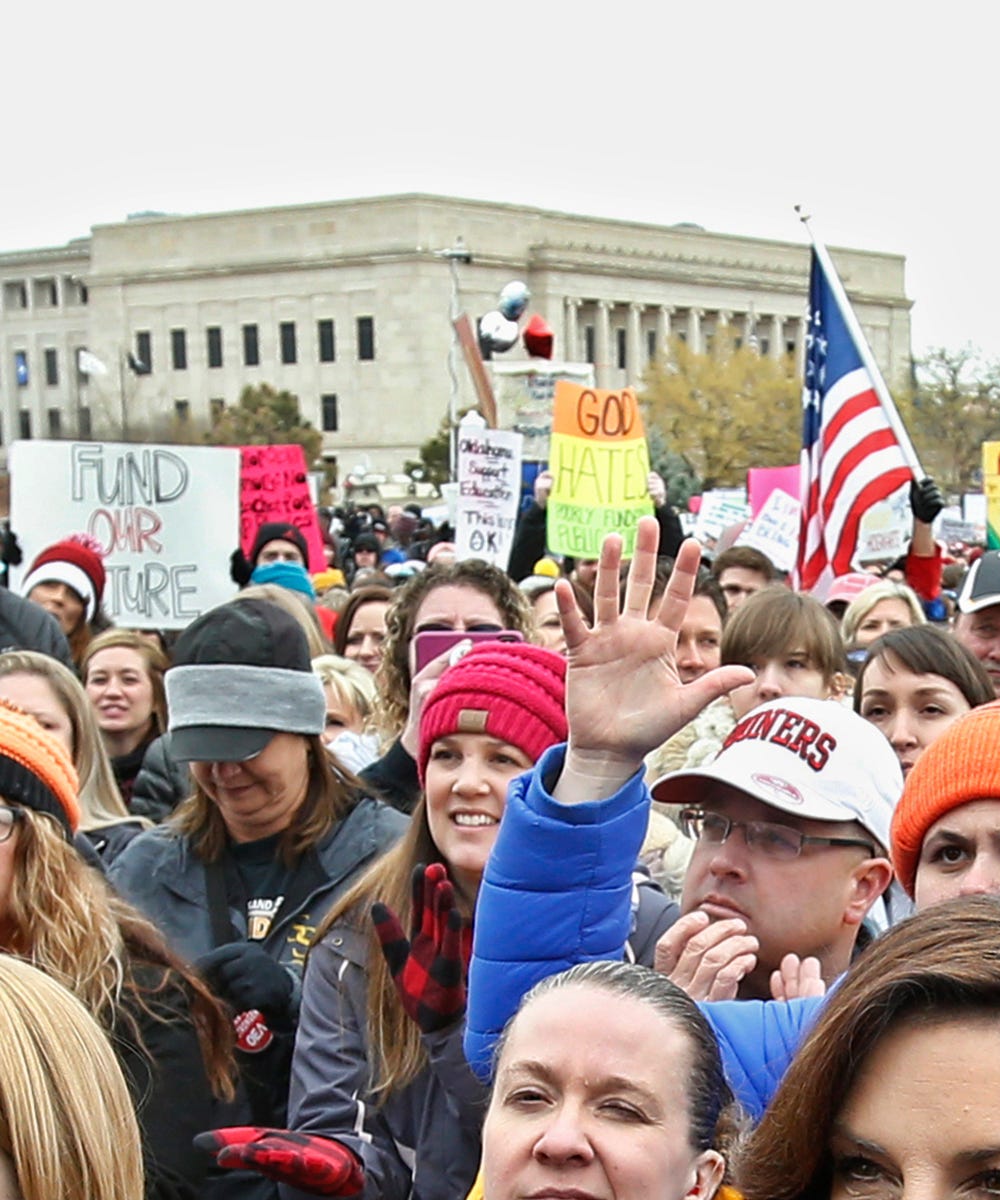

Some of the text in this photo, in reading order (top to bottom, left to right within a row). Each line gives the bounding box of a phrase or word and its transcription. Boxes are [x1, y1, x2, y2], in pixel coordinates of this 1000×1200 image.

[577, 390, 636, 436] GOD
[71, 444, 190, 506] FUND
[557, 443, 649, 503] HATES
[89, 508, 164, 556] OUR
[105, 561, 201, 619] TURE
